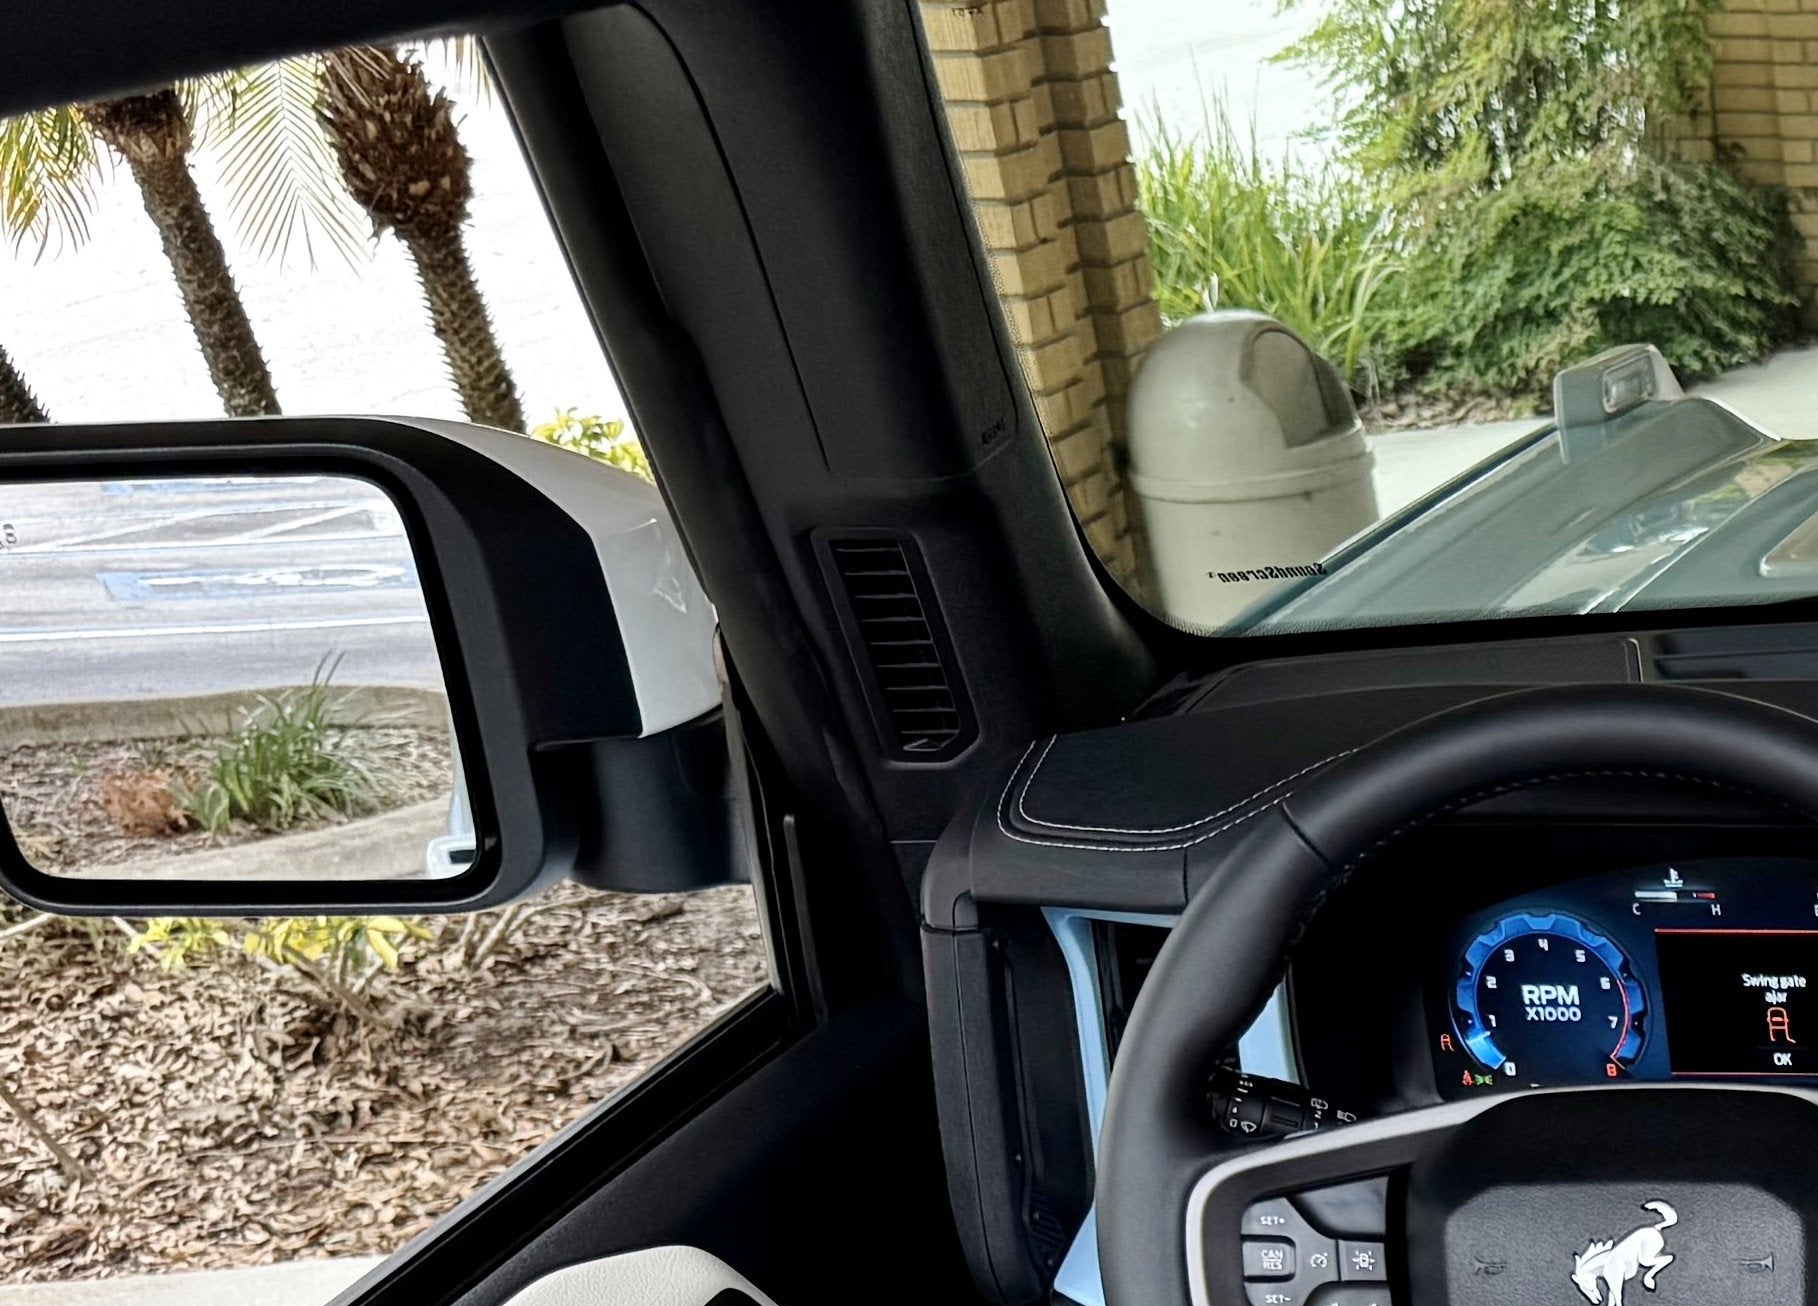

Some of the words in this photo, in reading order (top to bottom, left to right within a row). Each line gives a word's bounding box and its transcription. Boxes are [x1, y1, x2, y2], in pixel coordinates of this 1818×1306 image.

[1711, 904, 1721, 916] H
[1538, 938, 1549, 951] 4
[1504, 949, 1515, 962] 3
[1575, 950, 1586, 962] 5
[1486, 975, 1497, 988] 2
[1600, 977, 1611, 990] 6
[1741, 973, 1779, 989] Swing
[1780, 975, 1807, 989] gate
[1521, 984, 1581, 1006] RPM
[1764, 990, 1788, 1005] ajar
[1488, 1014, 1497, 1028] 1
[1526, 1006, 1582, 1022] X1000
[1607, 1015, 1618, 1029] 7
[1773, 1052, 1793, 1066] OK
[1504, 1062, 1516, 1077] 0
[1261, 1250, 1283, 1259] CAN
